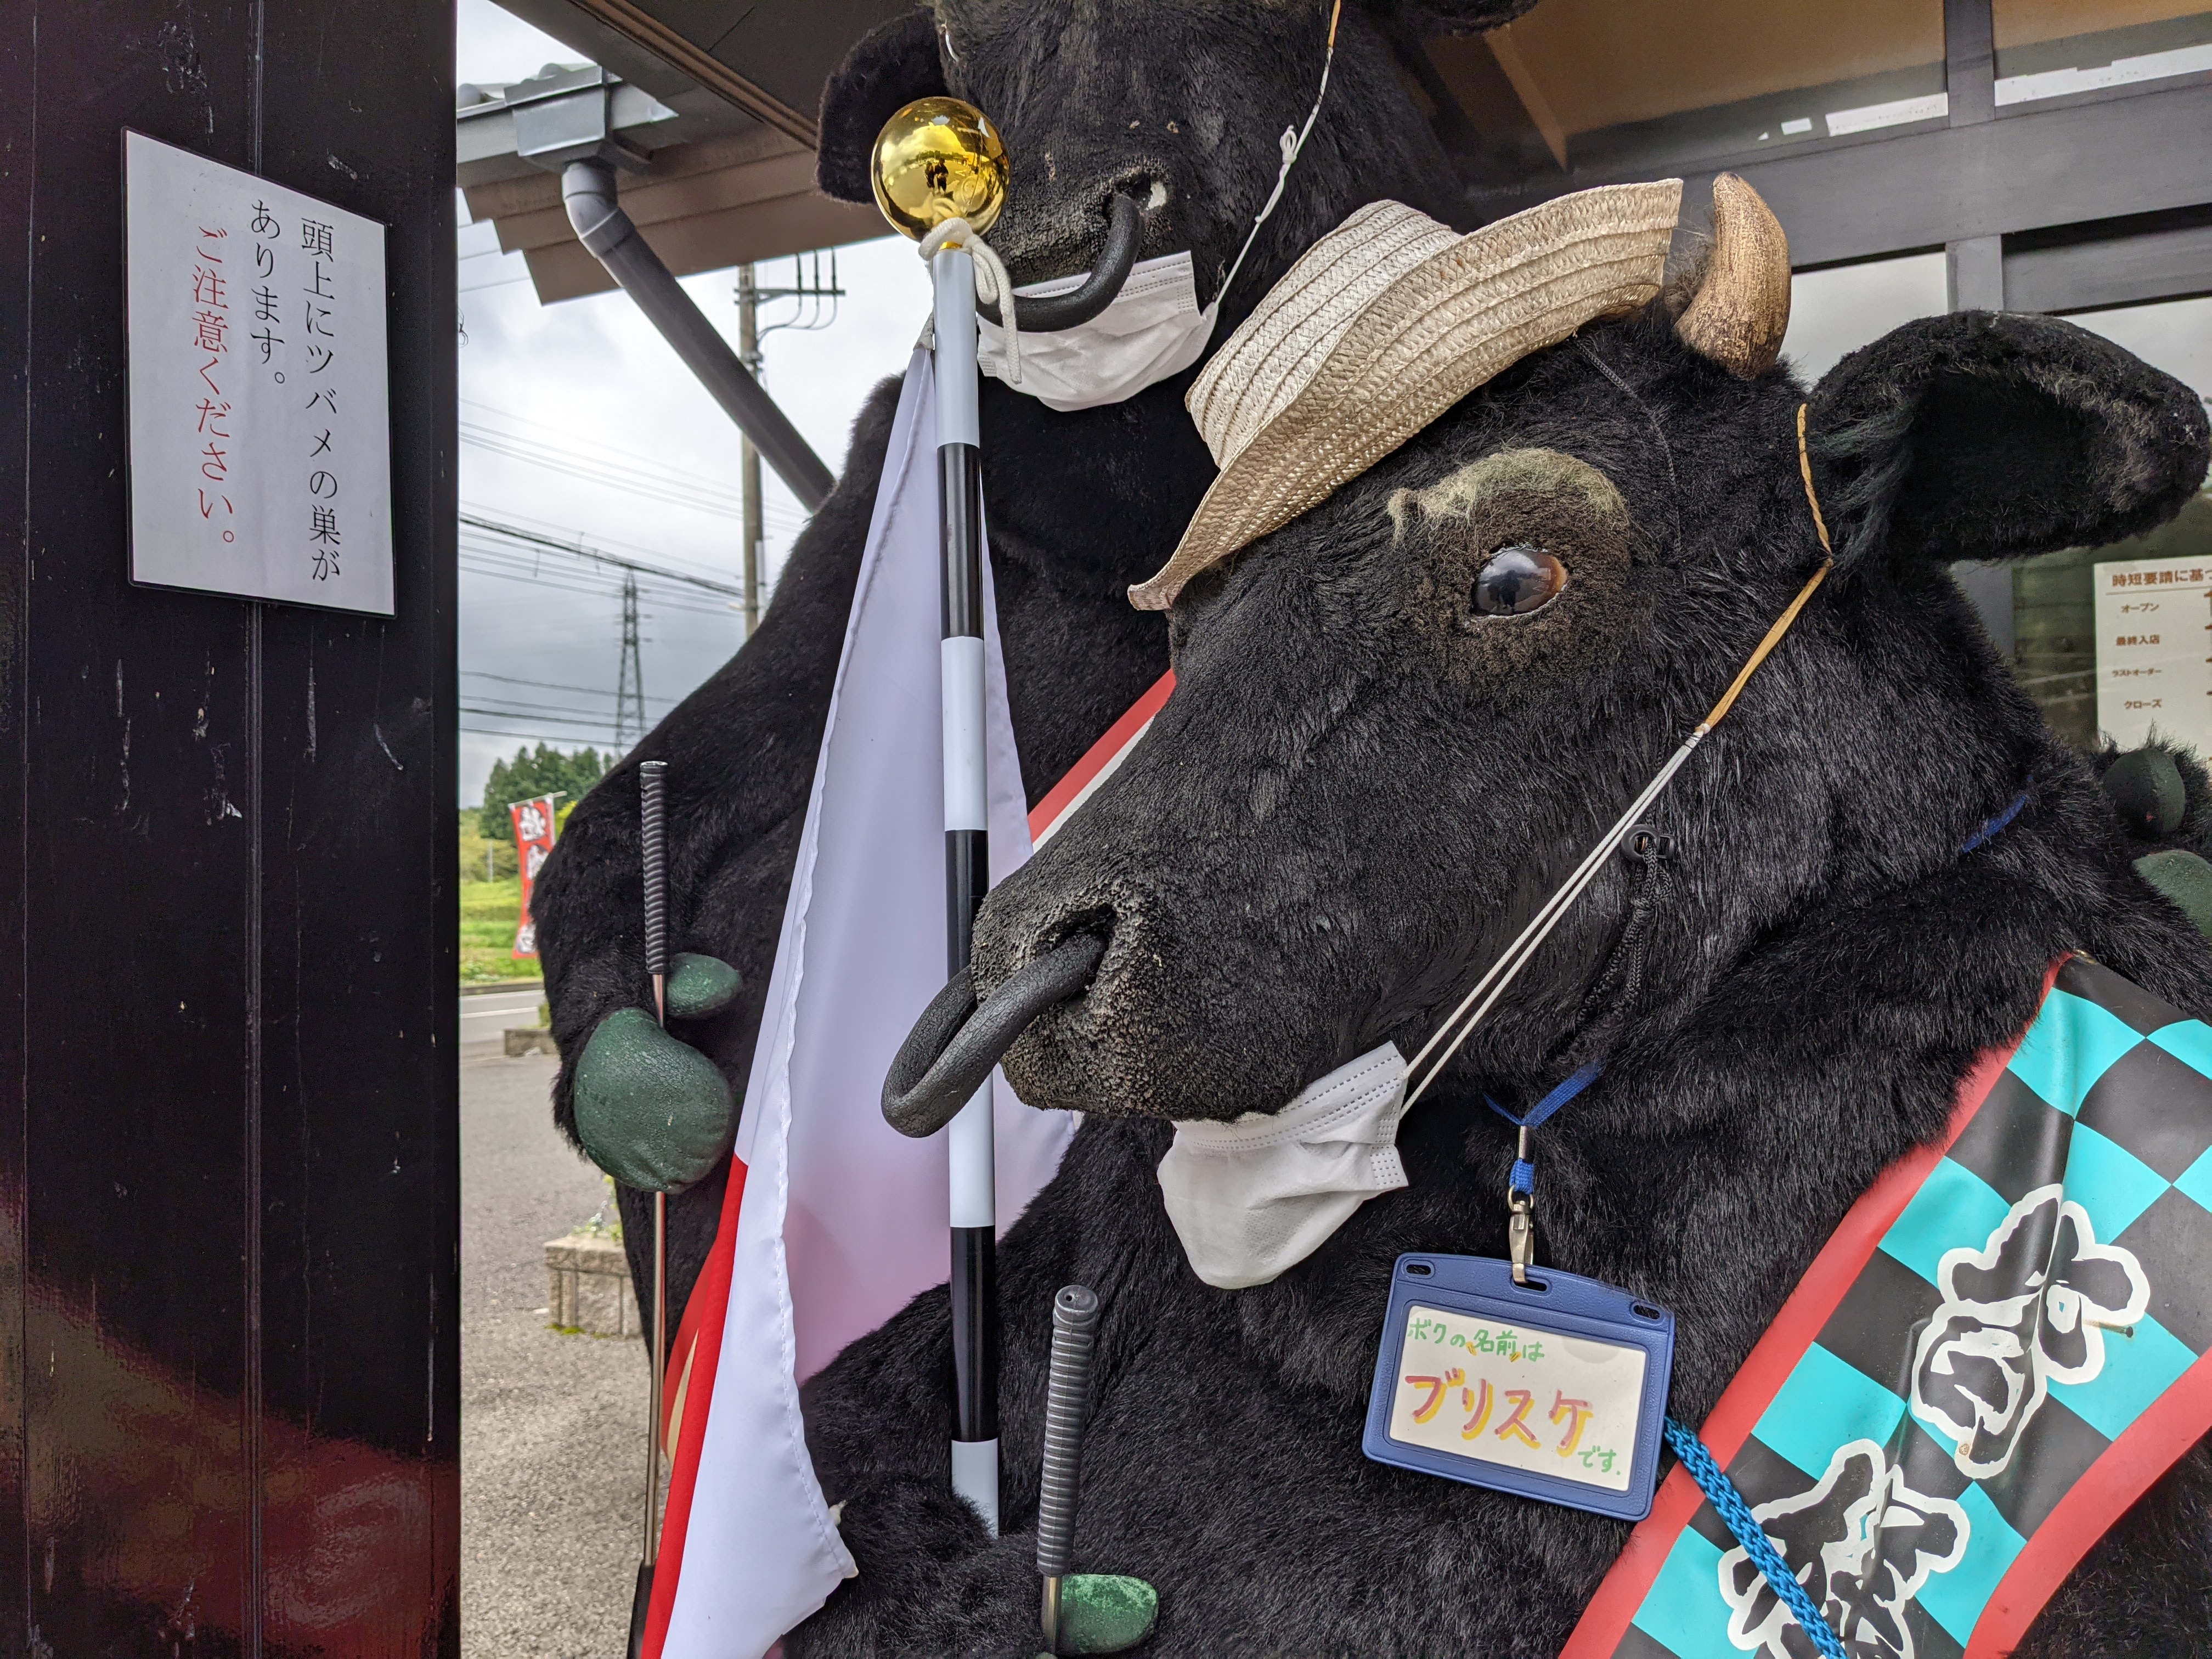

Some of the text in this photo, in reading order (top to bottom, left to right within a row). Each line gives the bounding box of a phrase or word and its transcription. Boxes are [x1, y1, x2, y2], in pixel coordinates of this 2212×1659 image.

[250, 199, 285, 385] あります。
[191, 225, 234, 544] ご注意ください。
[301, 217, 341, 582] 頭上にツバメの巣が
[2112, 668, 2162, 678] ラストオーダー
[2116, 634, 2160, 646] 最終入店
[2124, 699, 2163, 710] クローズ
[1408, 1317, 1545, 1362] ボクの名前は
[1404, 1368, 1593, 1458] ブリスケ
